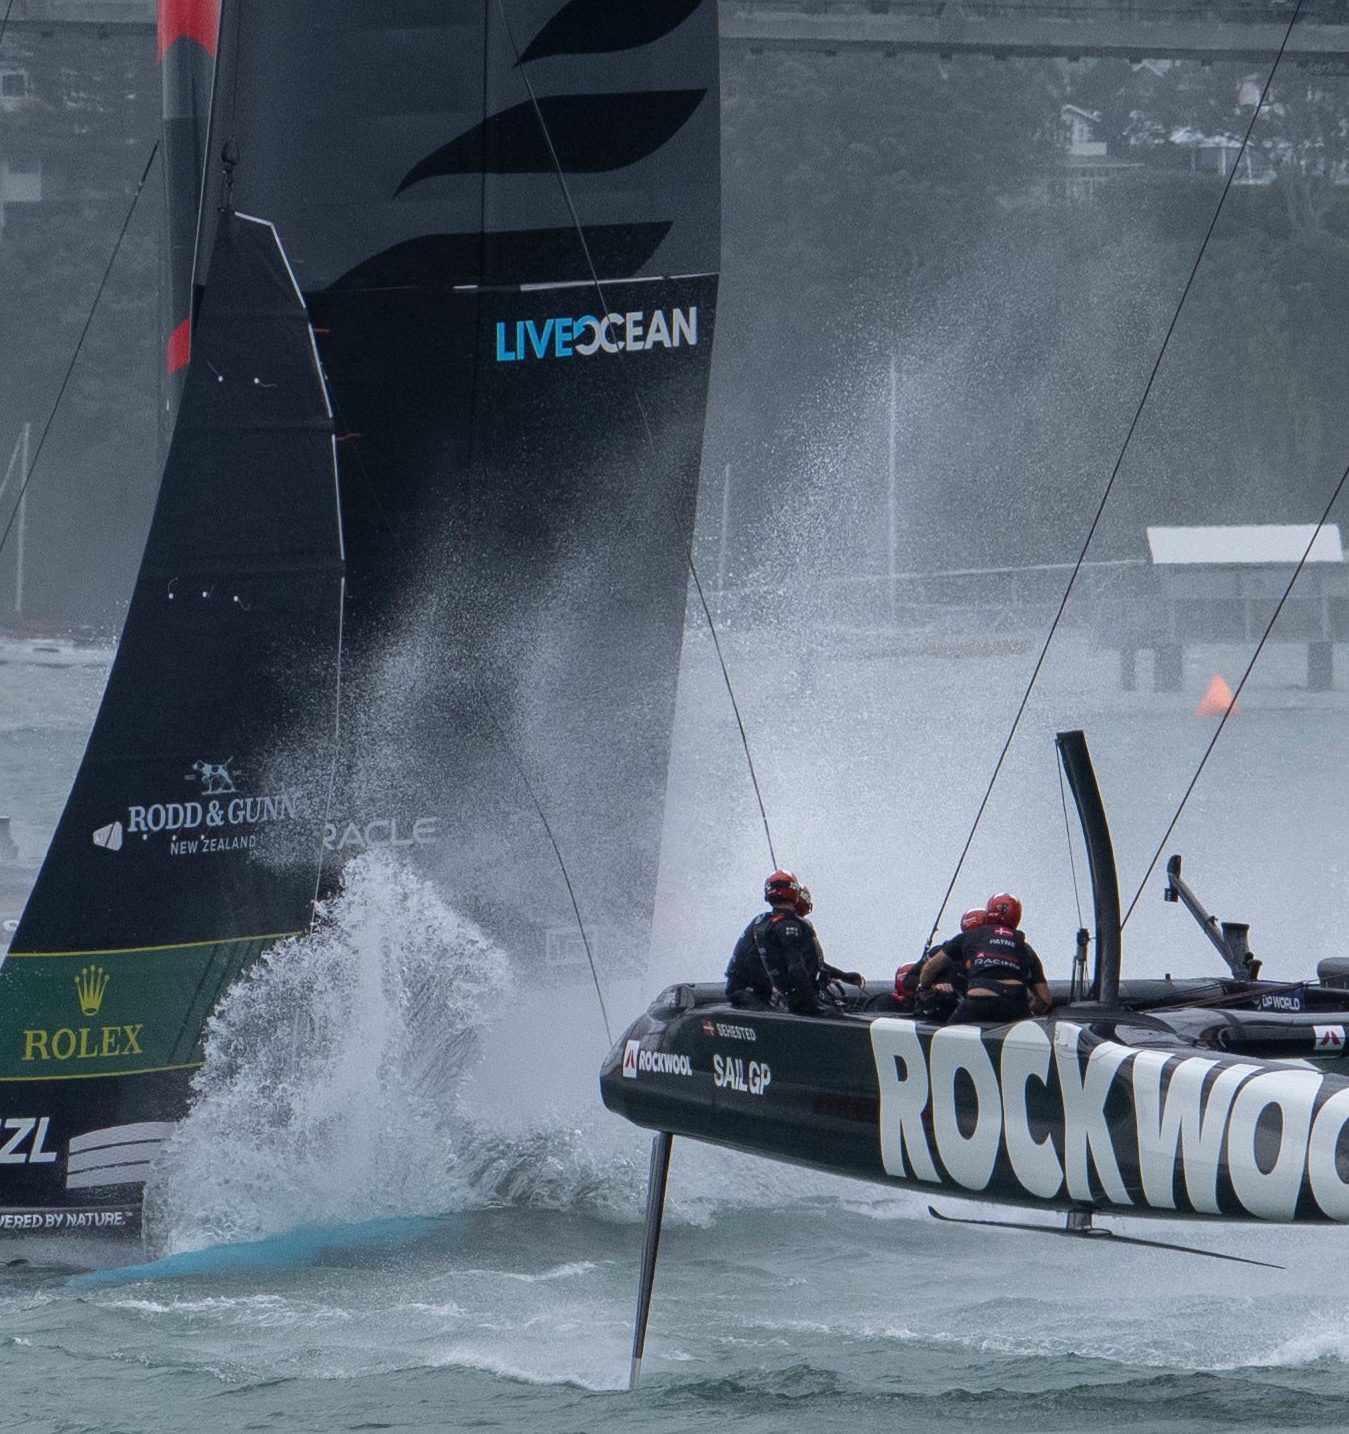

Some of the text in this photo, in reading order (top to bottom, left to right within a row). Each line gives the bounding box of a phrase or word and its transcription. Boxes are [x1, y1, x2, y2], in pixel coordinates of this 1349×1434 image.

[127, 792, 302, 832] RODD & GUNN
[323, 817, 440, 850] RACLE
[170, 835, 256, 855] NEW ZEALAND
[989, 938, 1016, 948] PAYNE
[1272, 996, 1300, 1011] WORLD
[22, 1024, 143, 1061] ROLEX
[716, 1023, 756, 1042] SEHESTED
[638, 1050, 693, 1076] ROCKWOOL
[45, 1214, 63, 1228] BY
